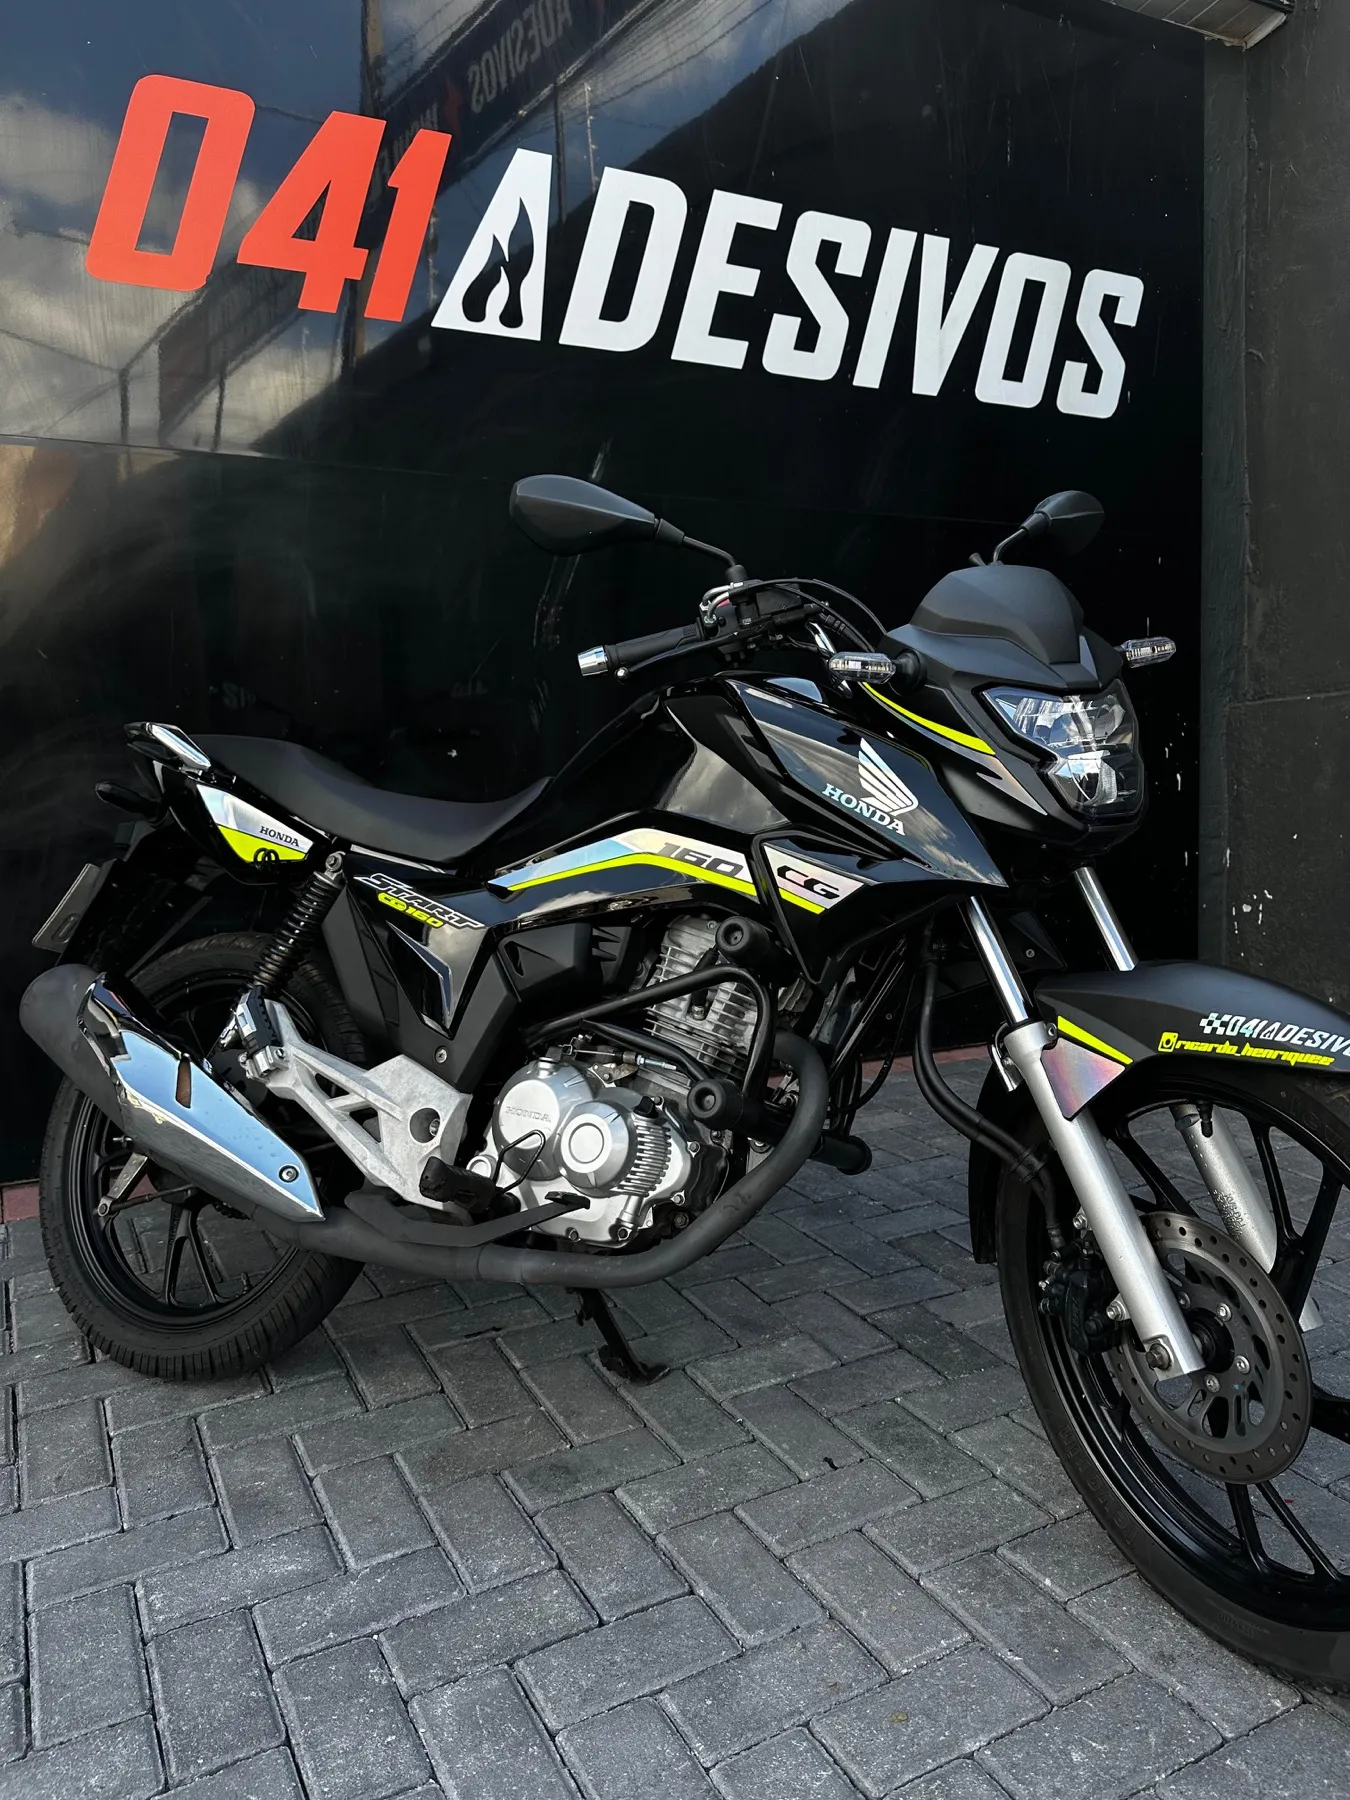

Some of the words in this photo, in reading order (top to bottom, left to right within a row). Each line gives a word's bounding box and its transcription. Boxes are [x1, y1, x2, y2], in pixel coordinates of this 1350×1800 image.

[431, 148, 1144, 420] ADESIVOS
[822, 783, 906, 836] HONDA
[260, 825, 300, 848] HONDA
[656, 841, 744, 878] 160
[776, 864, 840, 899] CG
[353, 872, 486, 929] START
[504, 1106, 552, 1123] HONDA
